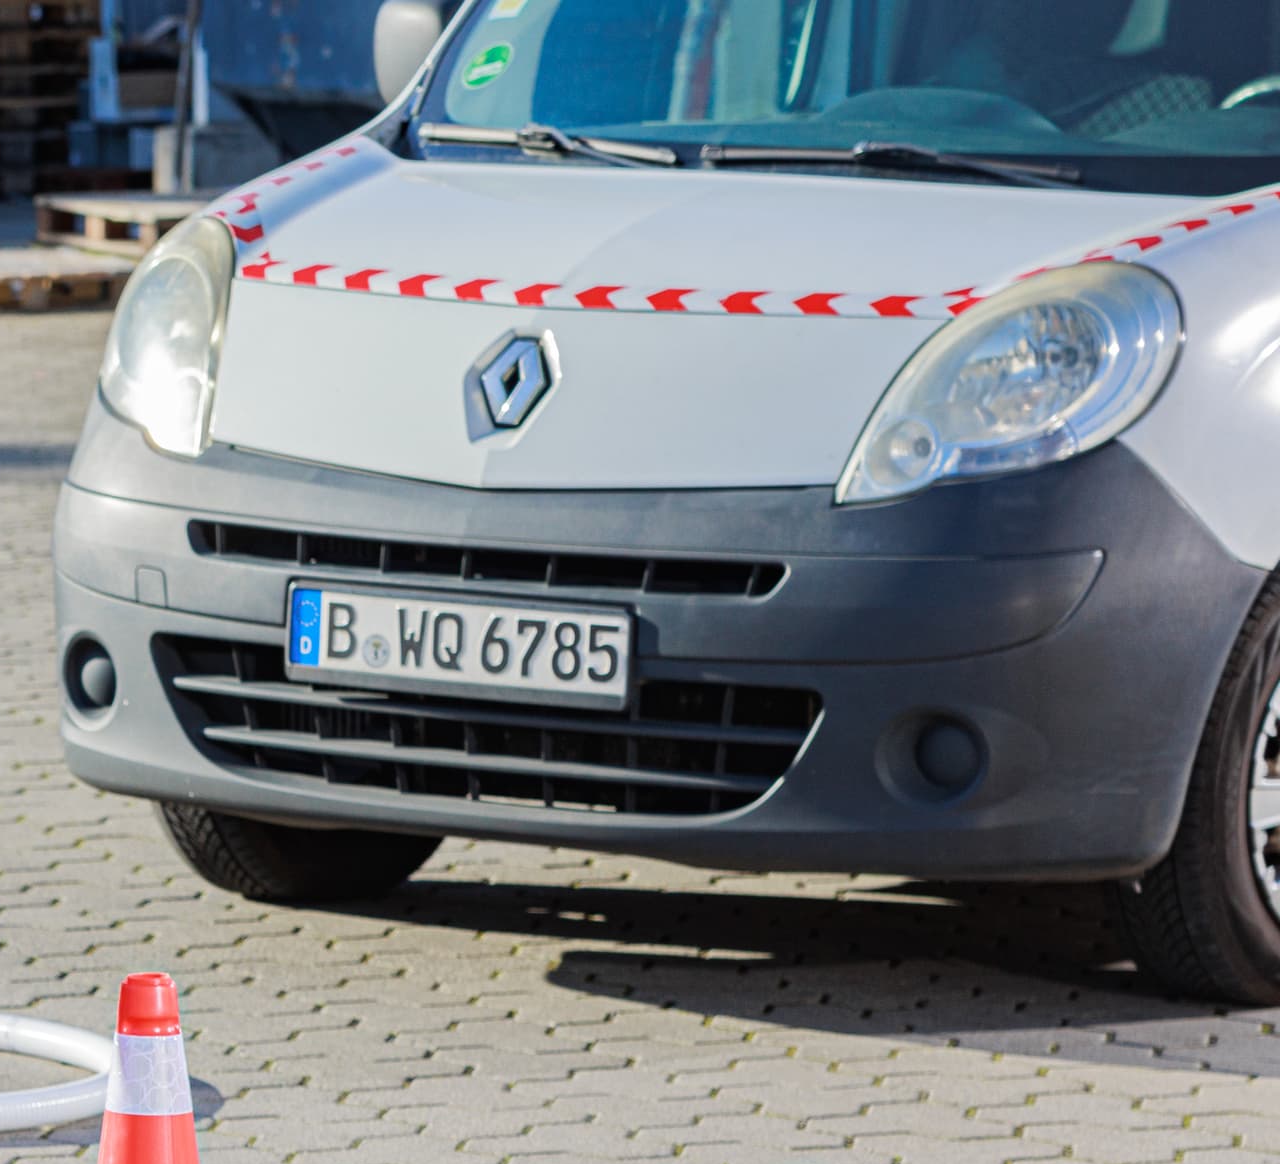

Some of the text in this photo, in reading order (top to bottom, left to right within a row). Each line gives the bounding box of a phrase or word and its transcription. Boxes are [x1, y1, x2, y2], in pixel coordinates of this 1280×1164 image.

[300, 636, 312, 655] D
[327, 602, 620, 682] B WQ 6785
